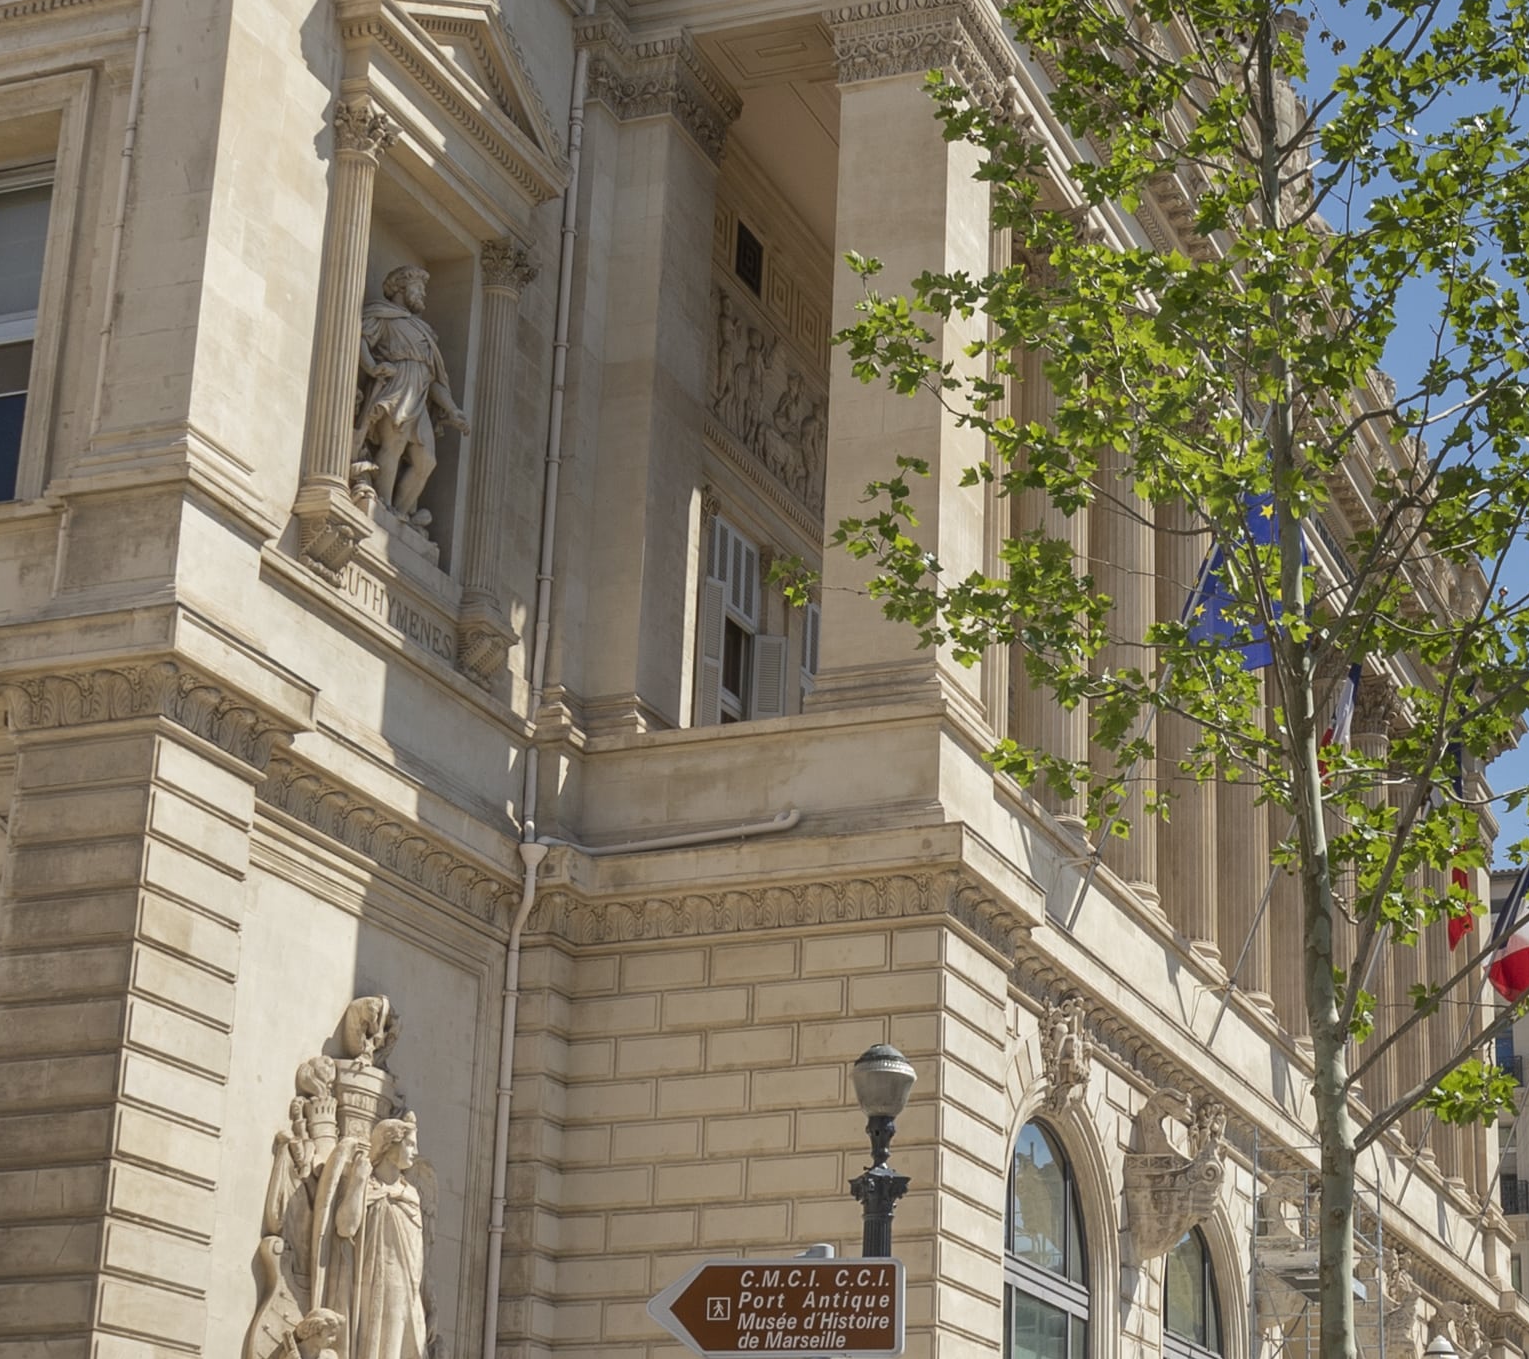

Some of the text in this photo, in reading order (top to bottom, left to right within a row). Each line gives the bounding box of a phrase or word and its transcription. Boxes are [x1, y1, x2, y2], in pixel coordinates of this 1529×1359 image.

[740, 1269, 890, 1288] C.M.C.I. C.C.I.
[737, 1291, 890, 1311] Port Antique
[737, 1311, 889, 1330] Musée d'Histoire
[738, 1331, 846, 1349] de Marseille
